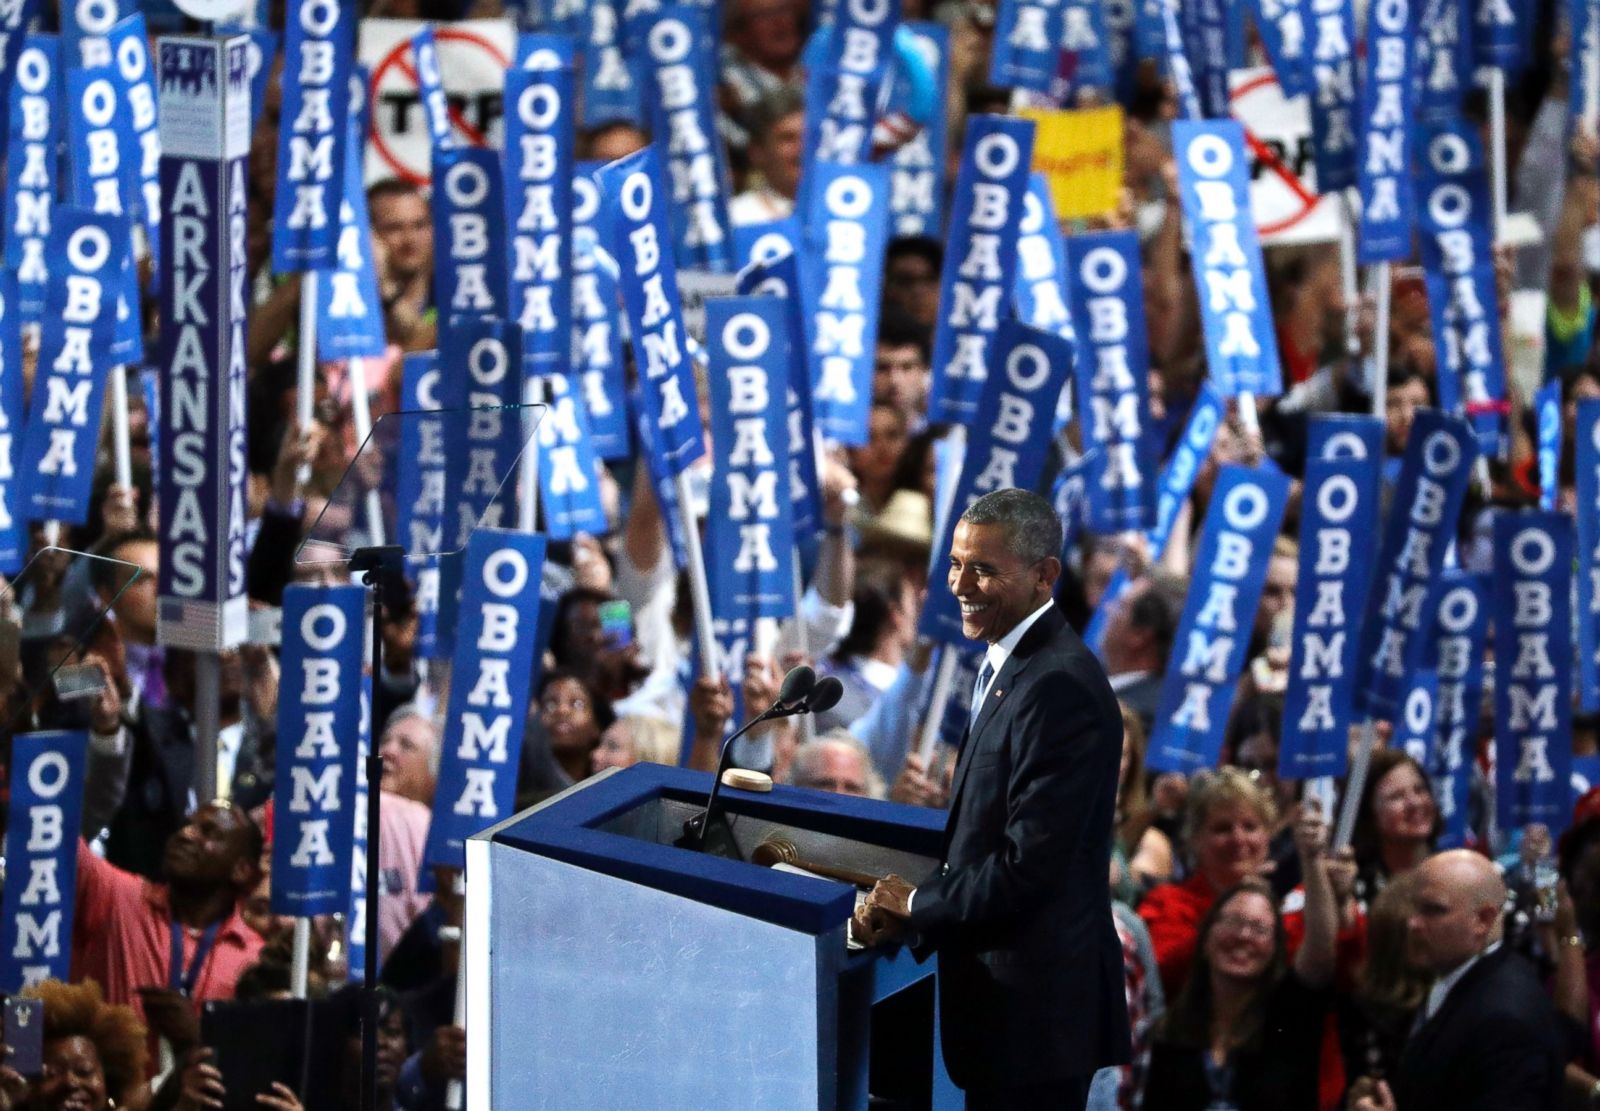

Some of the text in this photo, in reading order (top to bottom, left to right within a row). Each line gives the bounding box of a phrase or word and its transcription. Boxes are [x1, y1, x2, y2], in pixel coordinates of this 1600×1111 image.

[15, 48, 52, 285] OBAMA
[287, 0, 341, 229] OBAMA
[647, 18, 725, 248] OBAMA
[815, 0, 892, 164] OBAM
[445, 162, 497, 325] OBA
[513, 83, 561, 332] OBAMA
[620, 172, 690, 429] OBAMA
[812, 175, 873, 402] OBAMA
[945, 133, 1020, 380] OBAMA
[1186, 133, 1261, 356] OBAMA
[38, 225, 112, 477] OBAMA
[169, 162, 211, 598] ARKANSAS
[454, 338, 509, 550] OBAM
[721, 313, 780, 572] OBAMA
[966, 344, 1051, 506] OBA
[1080, 247, 1142, 490] OBAMA
[1171, 482, 1269, 732] OBAMA
[1298, 474, 1359, 731] OBAMA
[1372, 430, 1461, 679] OBAMA
[1507, 527, 1559, 782] OBAMA
[289, 603, 347, 867] OBAMA
[453, 548, 529, 818] OBAMA
